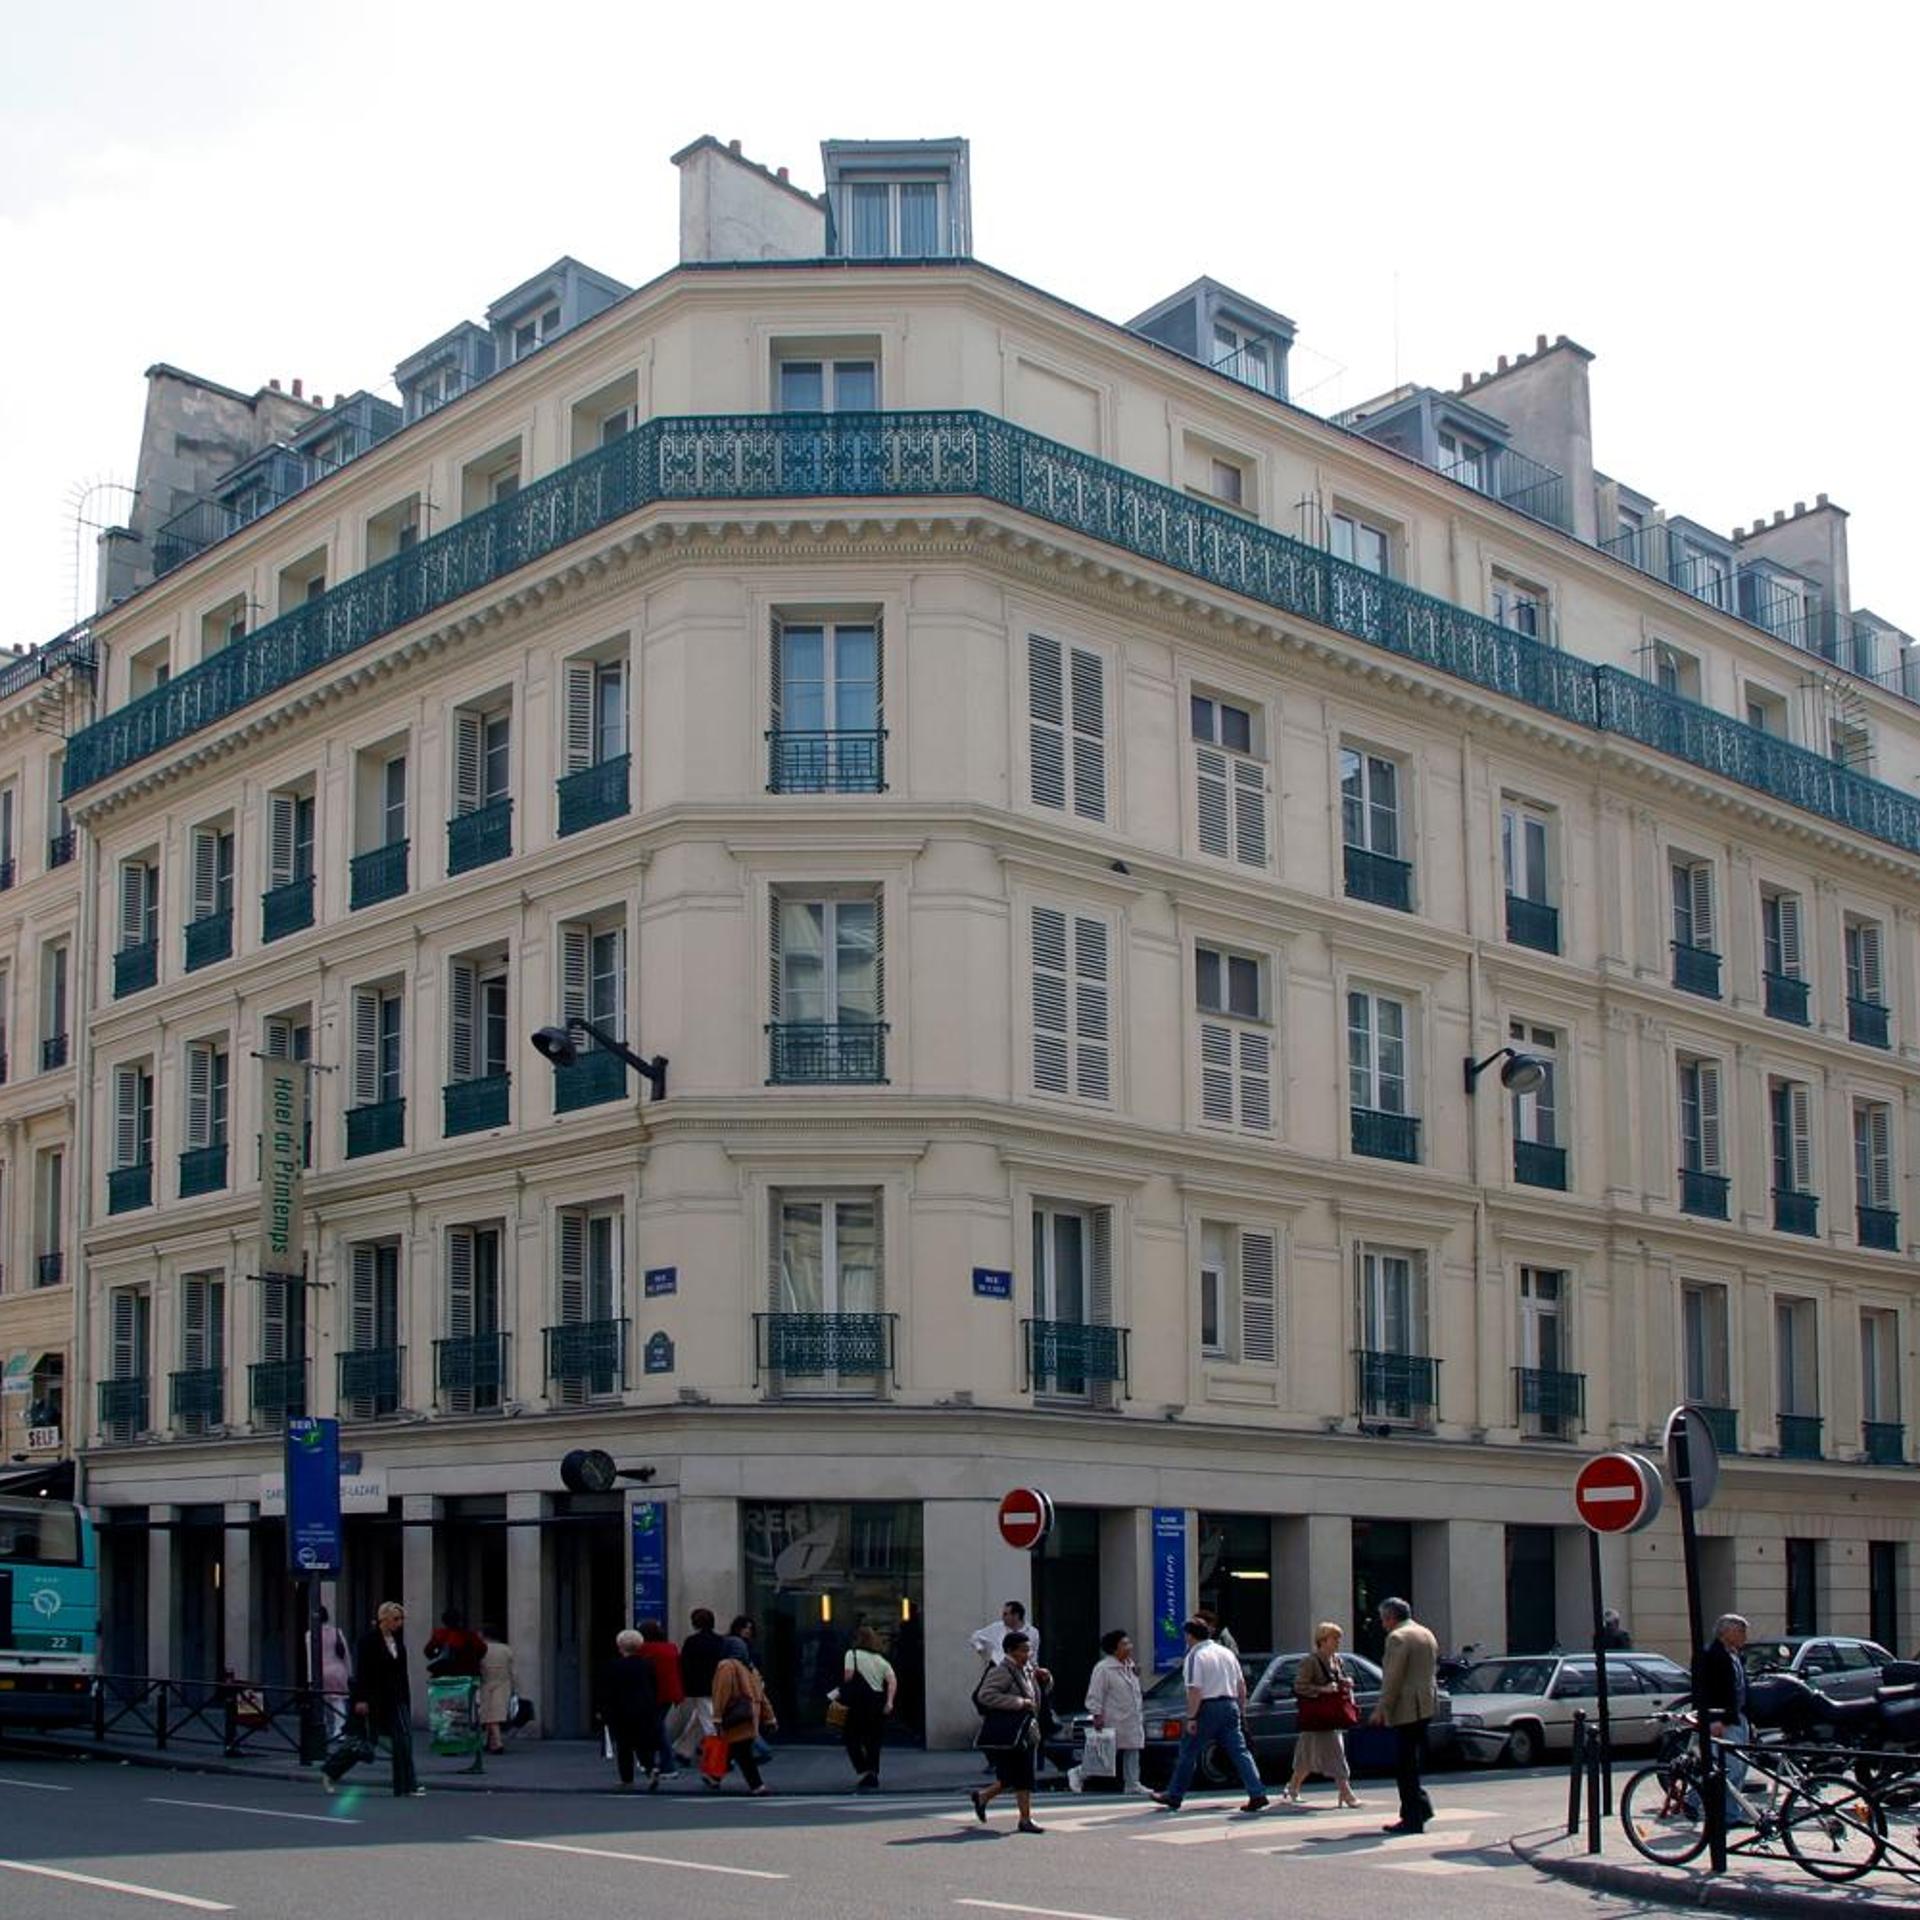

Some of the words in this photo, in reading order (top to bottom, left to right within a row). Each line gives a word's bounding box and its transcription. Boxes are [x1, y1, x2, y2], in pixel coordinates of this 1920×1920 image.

[273, 1132, 295, 1153] du
[268, 1161, 295, 1254] Printemps
[28, 1429, 57, 1447] SELF
[747, 1508, 808, 1533] RER
[51, 1636, 68, 1649] 22
